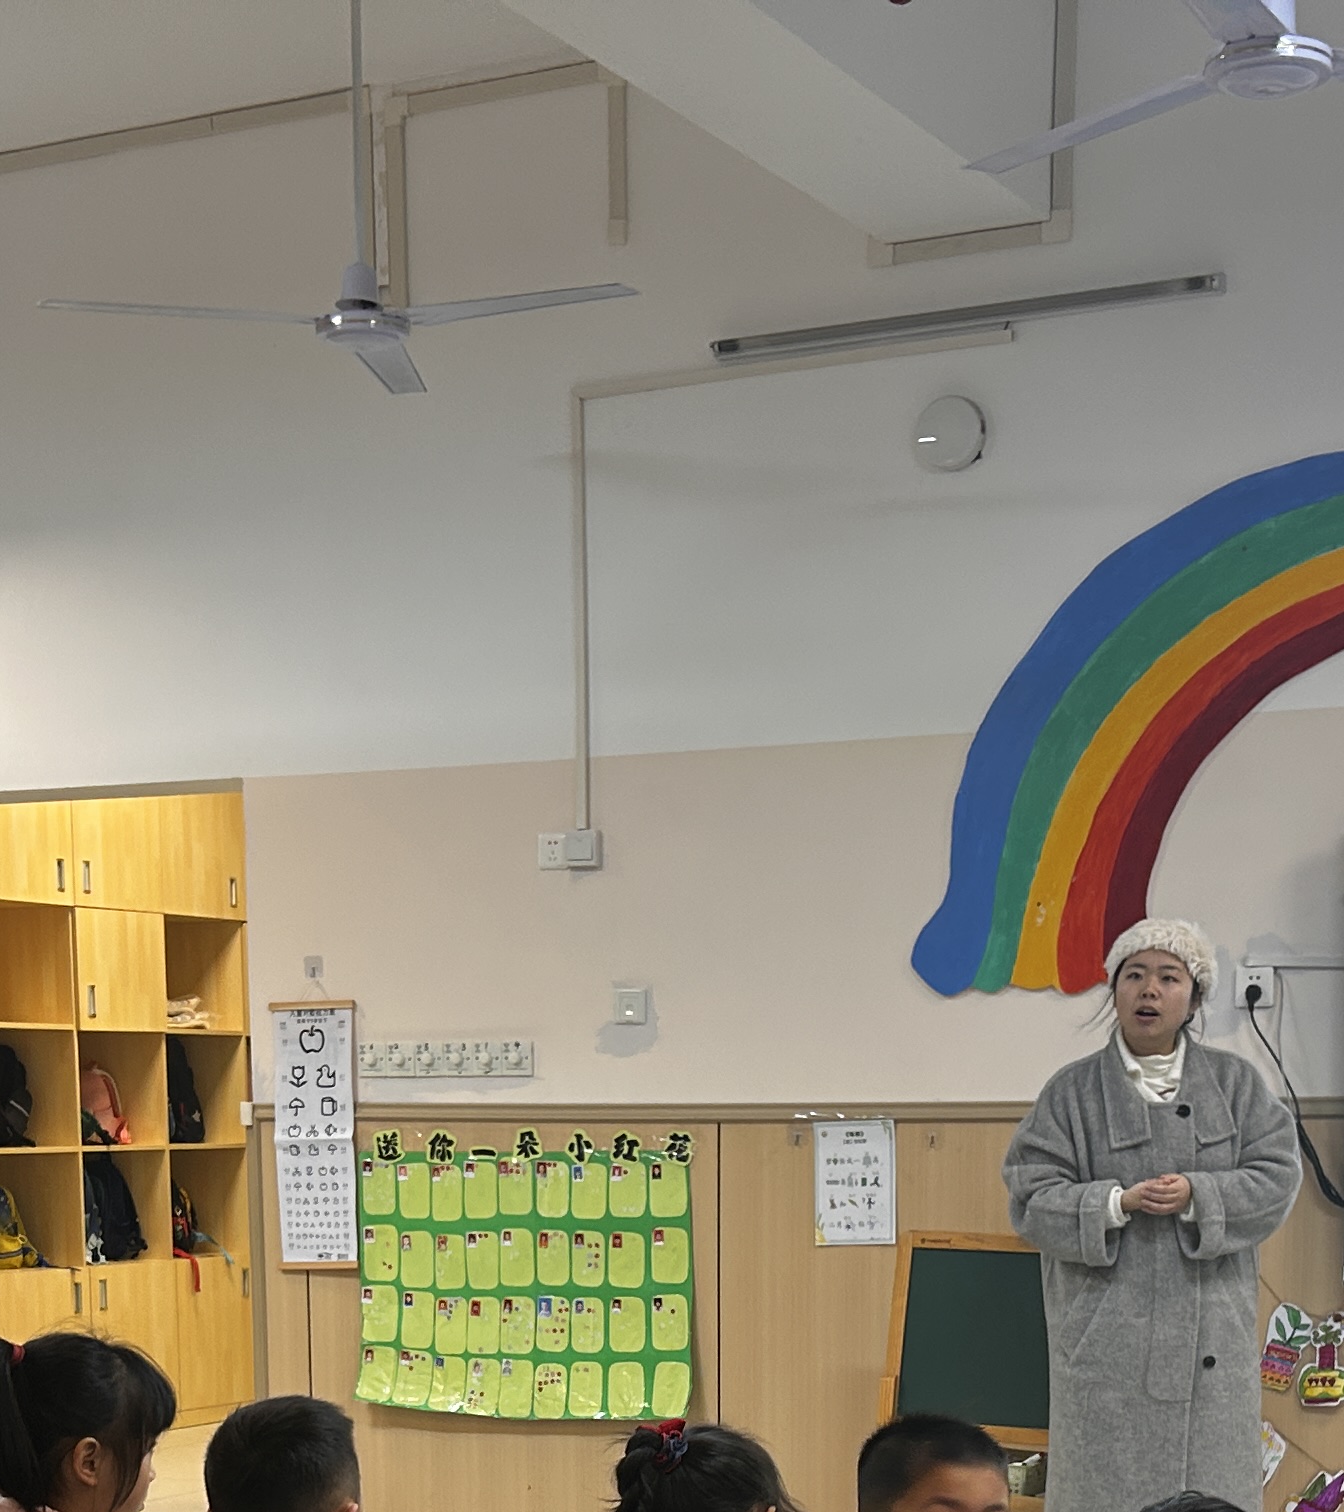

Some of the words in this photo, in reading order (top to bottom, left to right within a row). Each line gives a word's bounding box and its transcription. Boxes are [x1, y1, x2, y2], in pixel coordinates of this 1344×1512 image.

[376, 1131, 691, 1163] 送你一朵小红花
